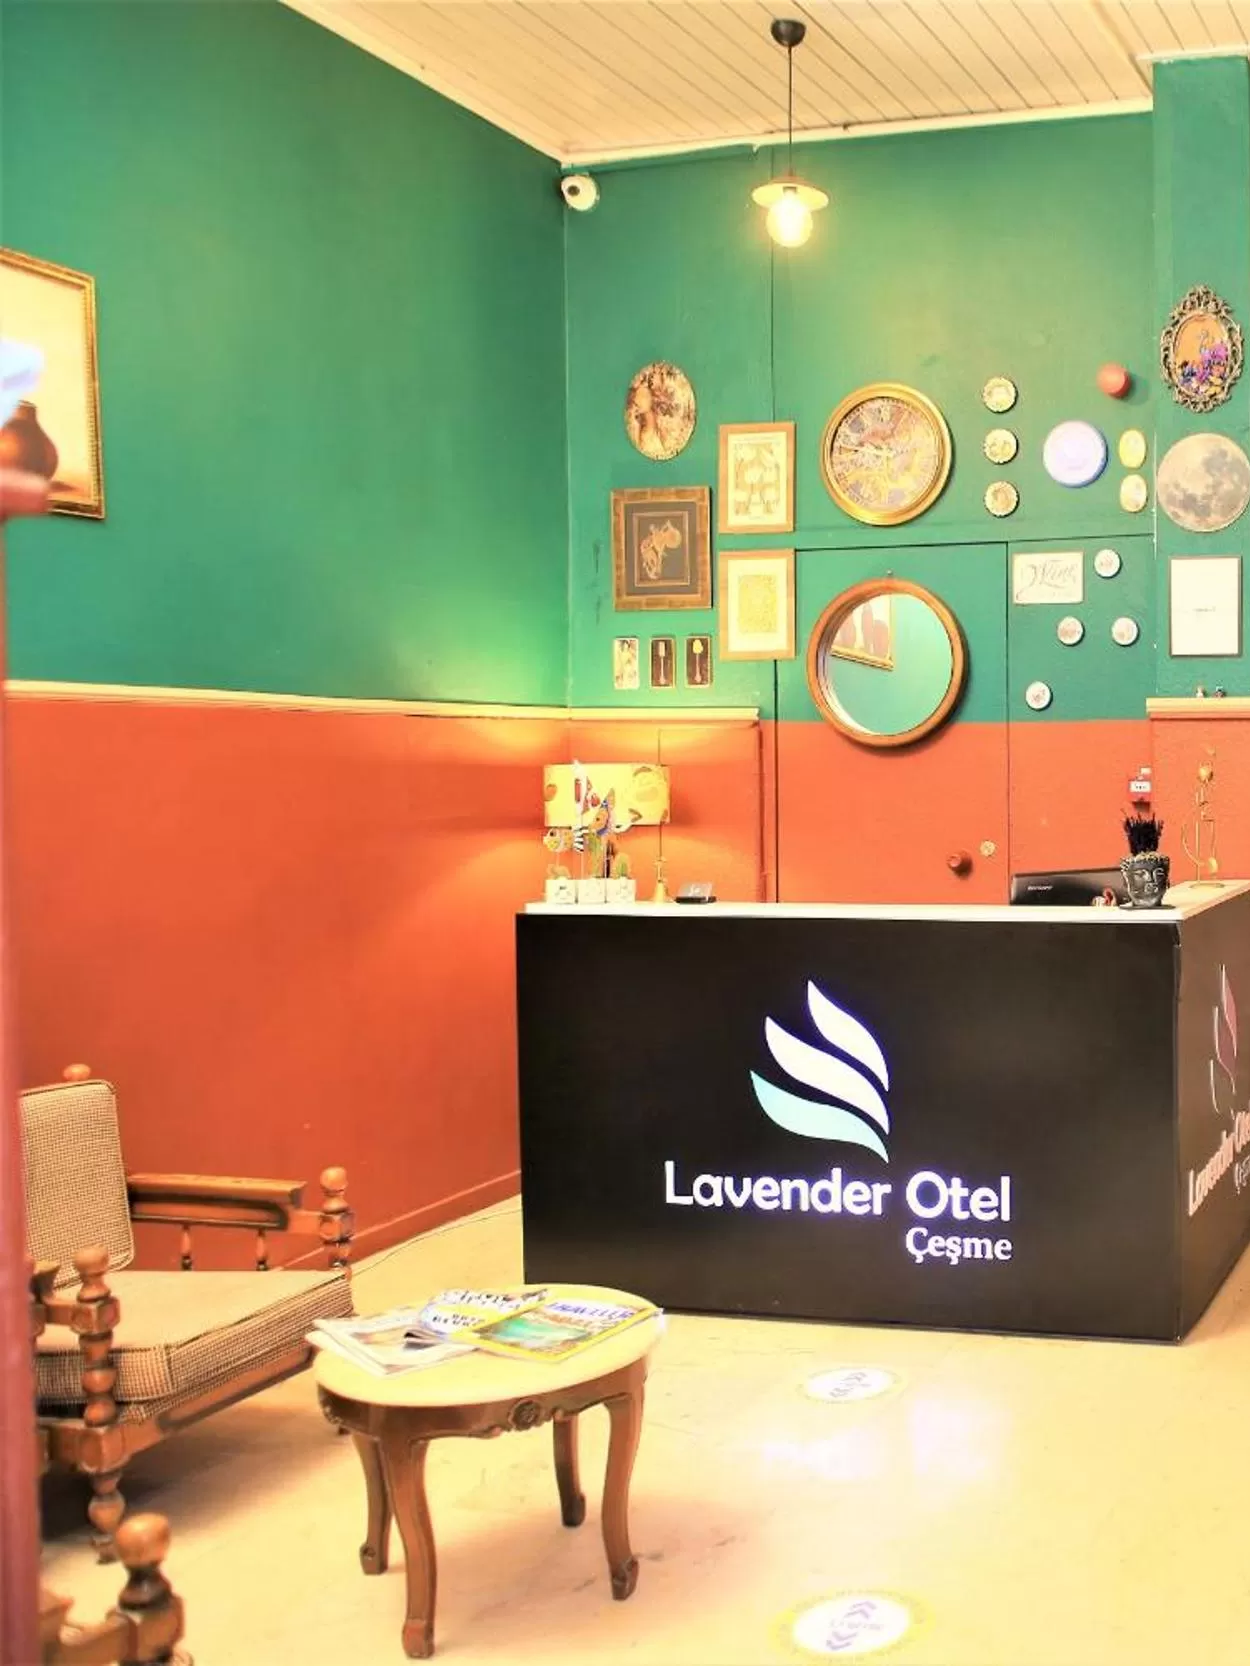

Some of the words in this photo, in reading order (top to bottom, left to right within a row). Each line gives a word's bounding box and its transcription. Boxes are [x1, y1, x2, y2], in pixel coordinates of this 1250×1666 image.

[664, 1161, 892, 1216] Lavender
[905, 1170, 1011, 1222] Otel
[905, 1226, 1013, 1266] Çeşme
